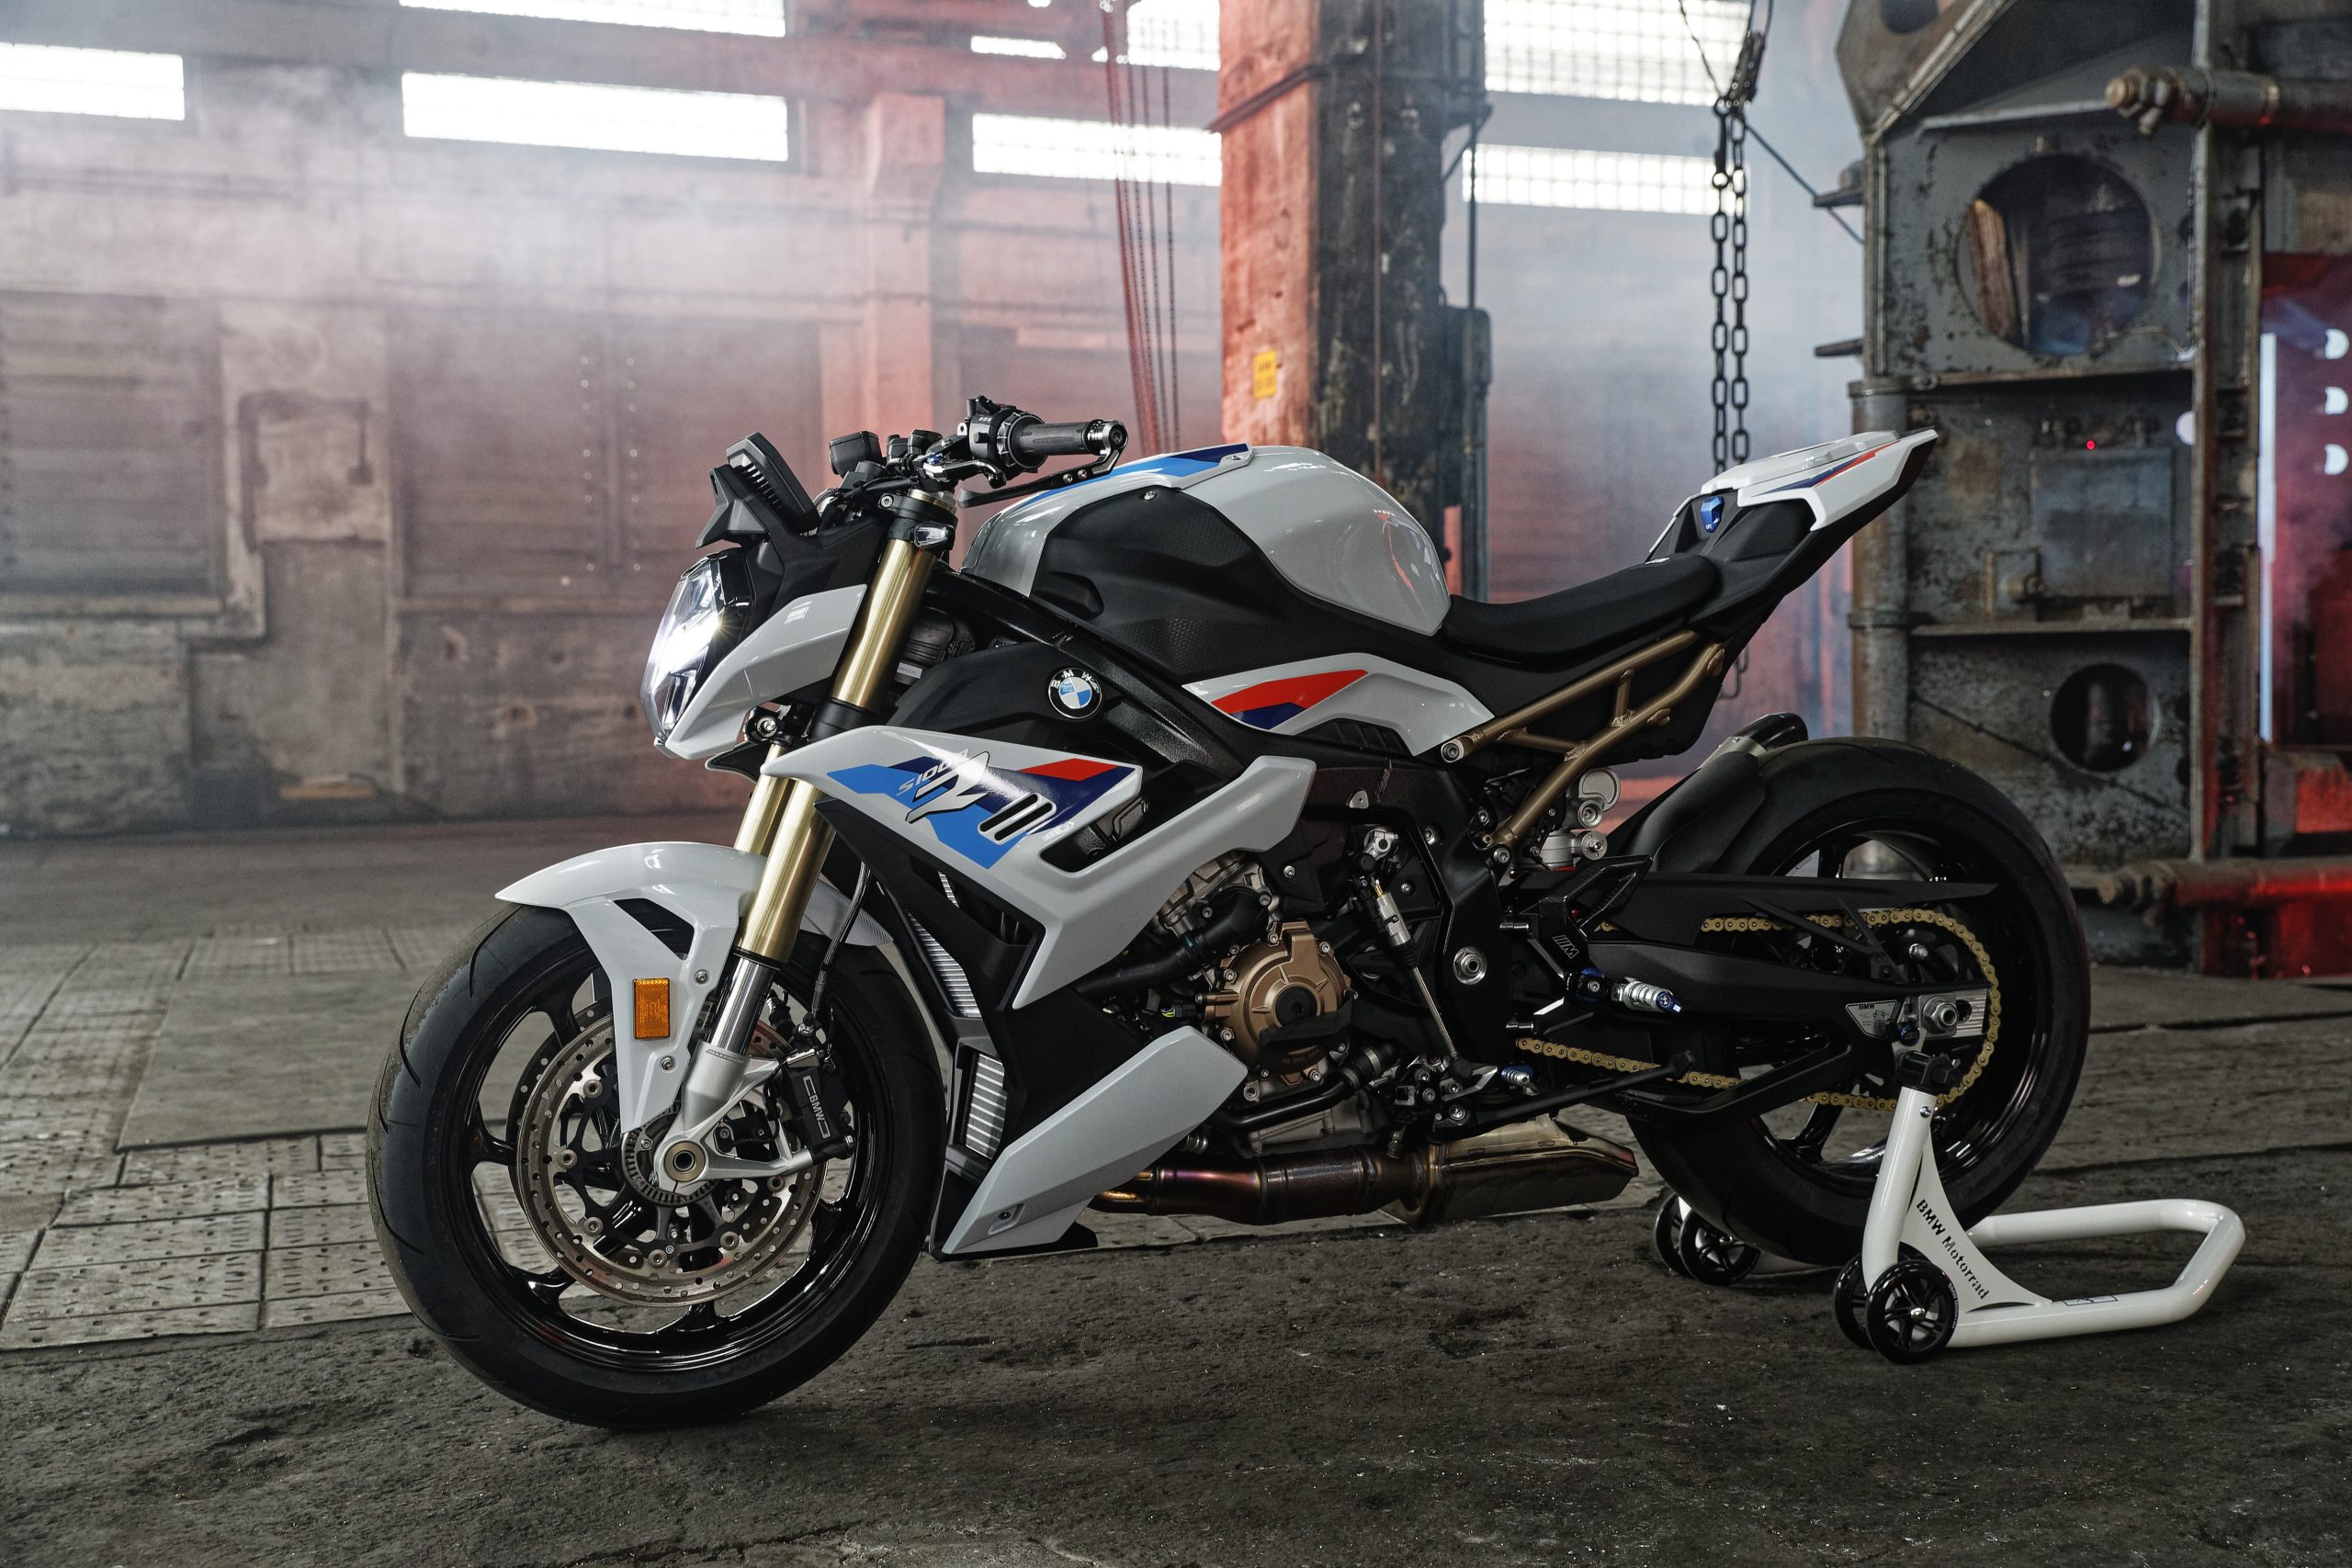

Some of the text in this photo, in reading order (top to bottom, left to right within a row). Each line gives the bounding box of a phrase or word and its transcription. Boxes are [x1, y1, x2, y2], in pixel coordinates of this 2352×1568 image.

[1050, 669, 1092, 690] BMW
[808, 1094, 826, 1122] BMW
[1916, 1199, 1990, 1300] BMW Motorrad
